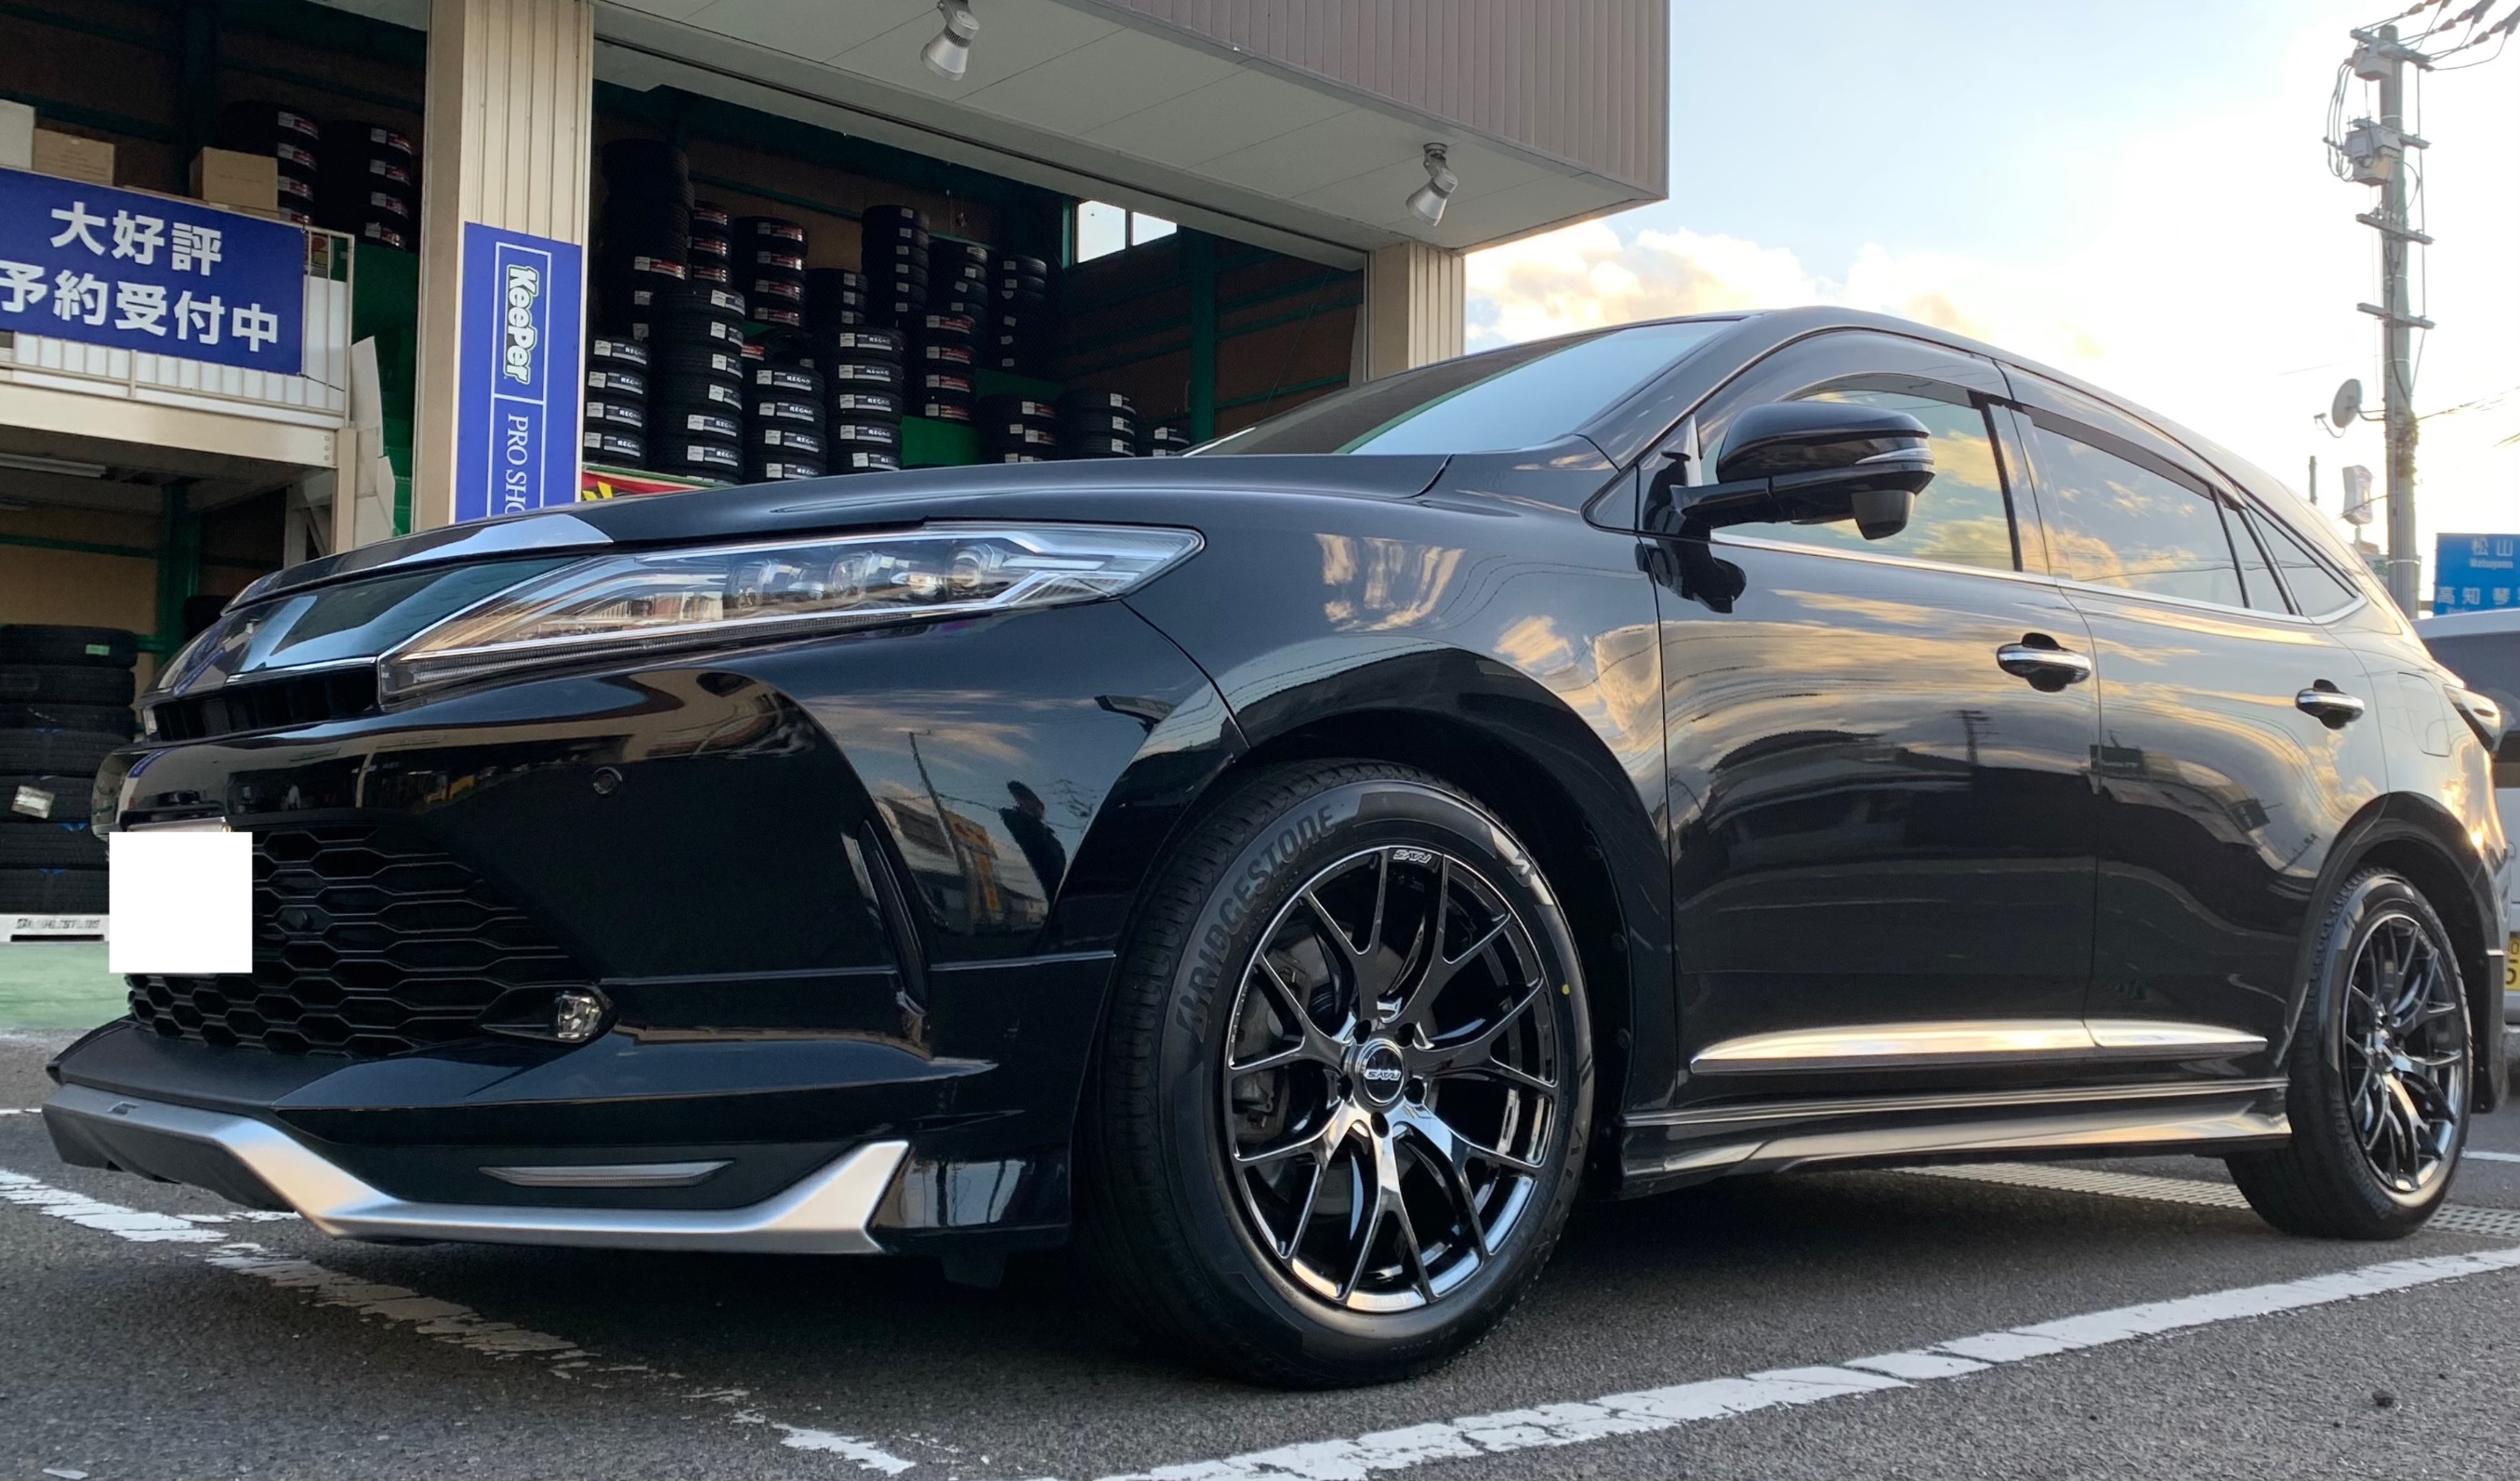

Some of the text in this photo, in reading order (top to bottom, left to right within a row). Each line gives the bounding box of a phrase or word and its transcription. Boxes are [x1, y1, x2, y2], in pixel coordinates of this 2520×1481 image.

[50, 201, 222, 276] 大好評
[0, 259, 278, 352] 予約受付中
[503, 264, 539, 385] KeePer
[507, 414, 528, 466] PRO
[1176, 804, 1337, 1043] BRIDGESTONE
[1364, 1068, 1402, 1081] RAYS
